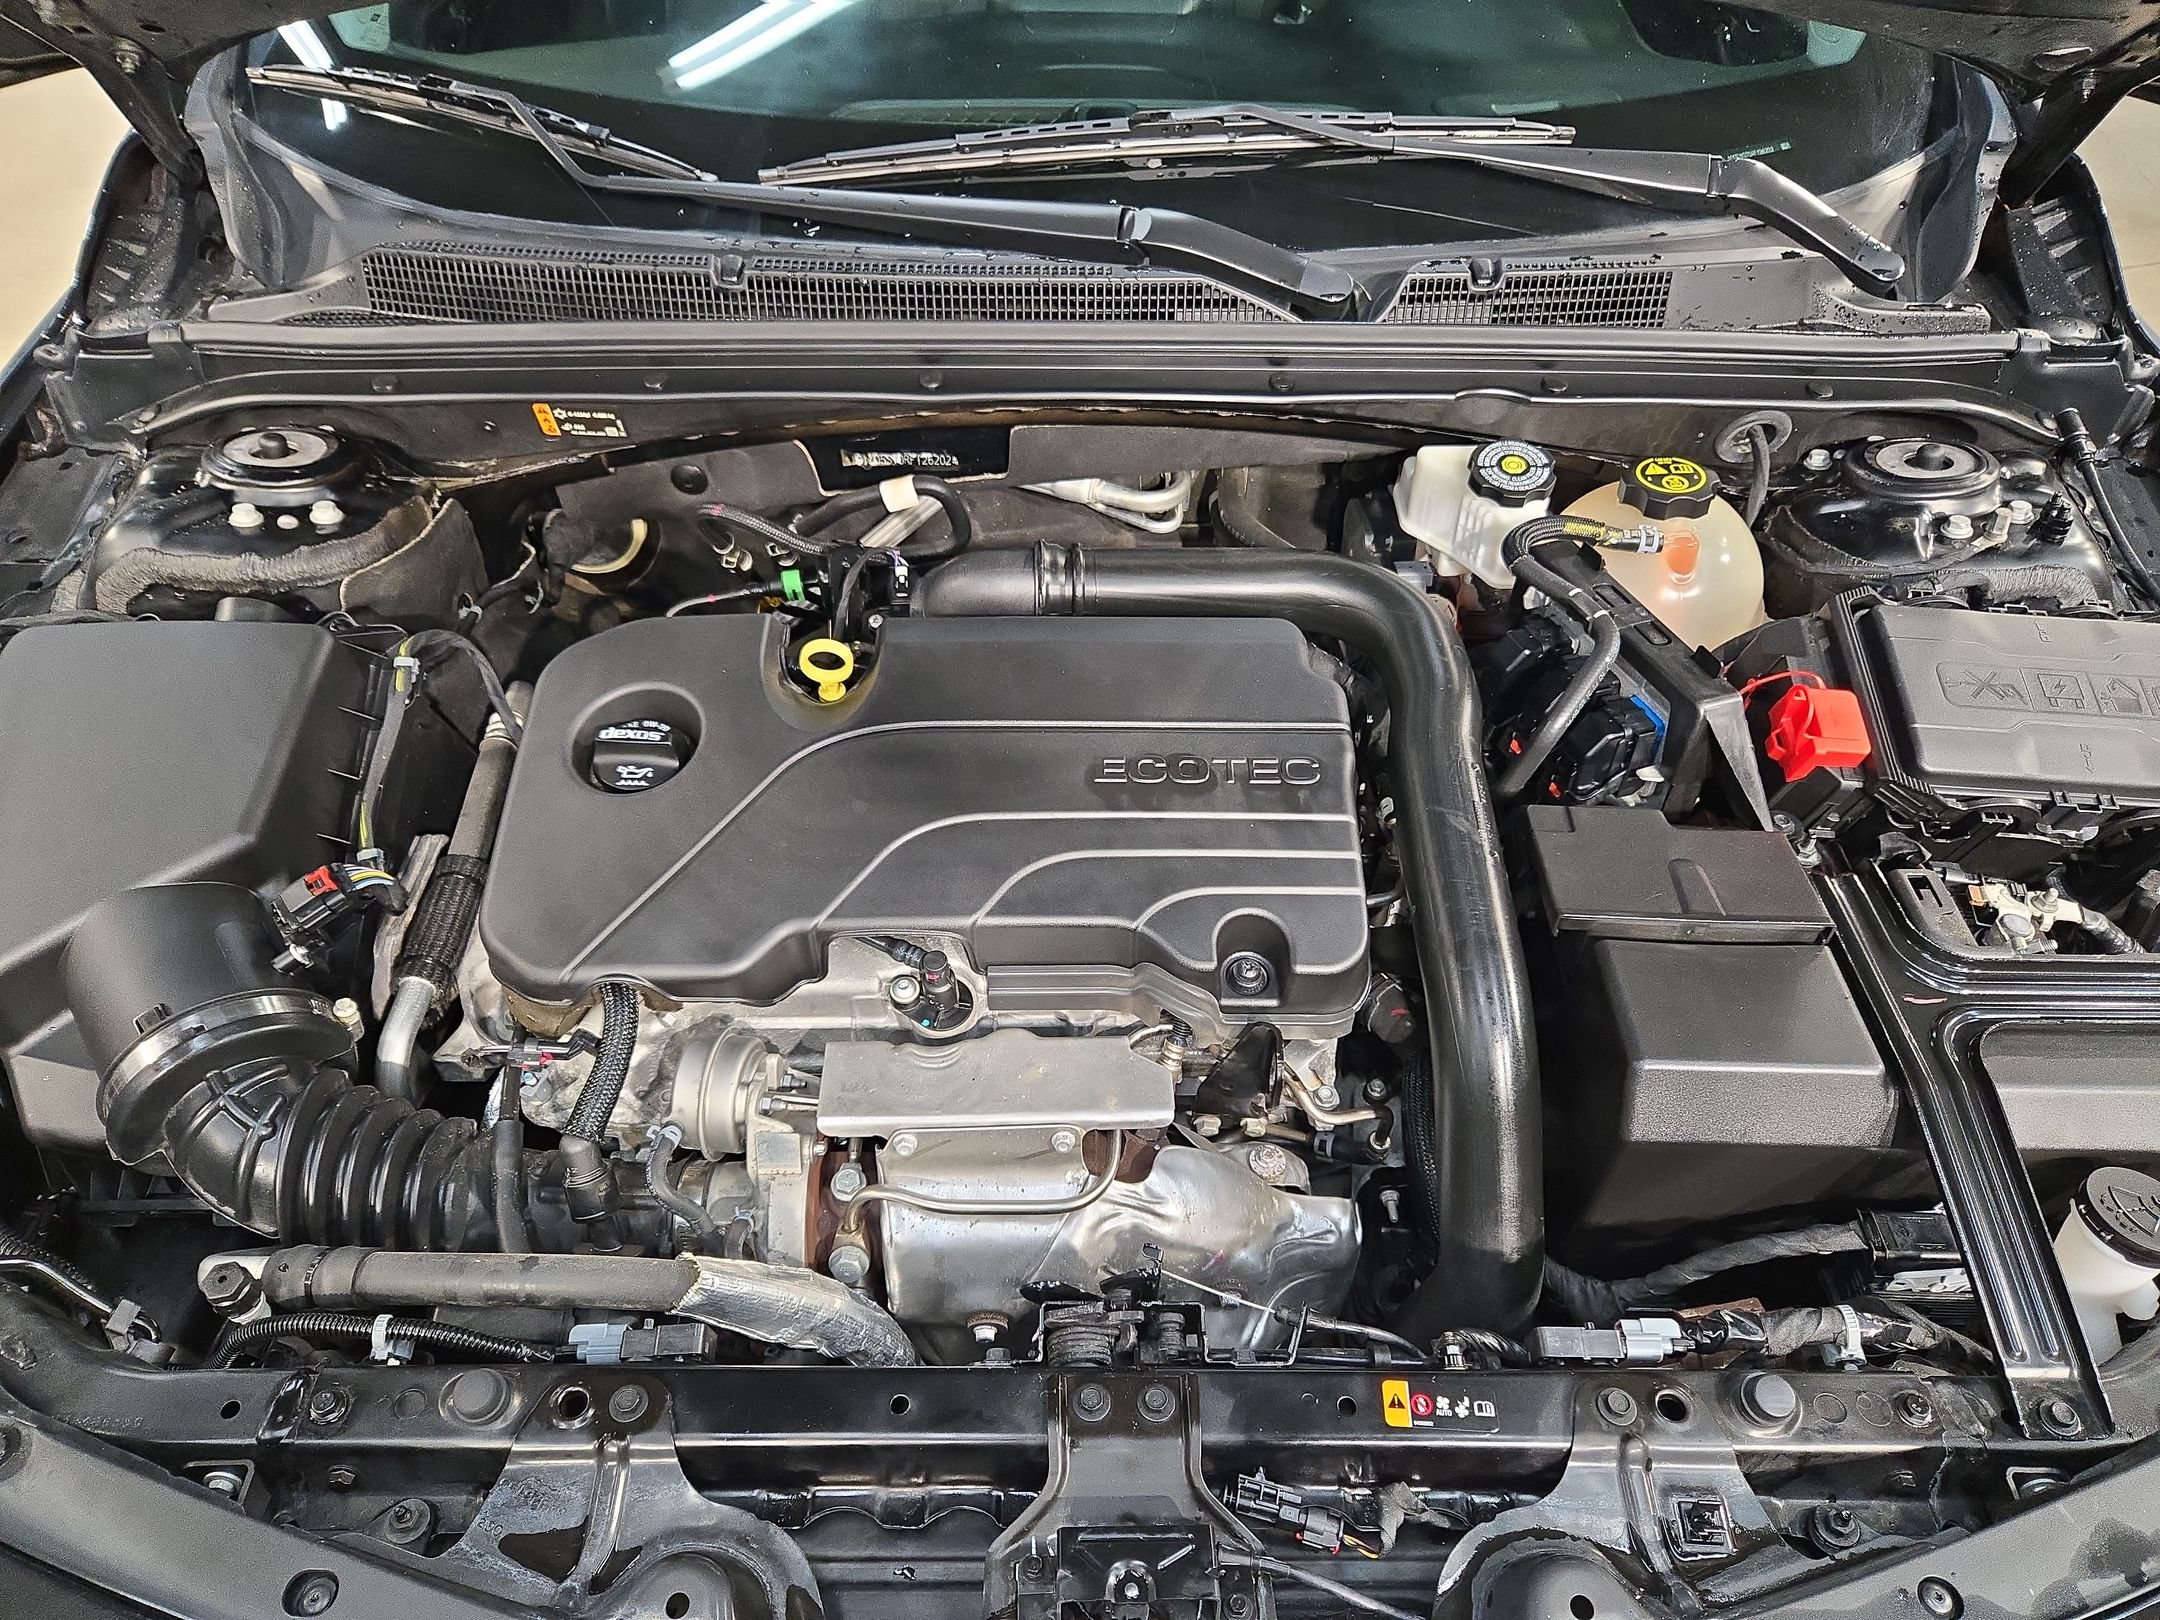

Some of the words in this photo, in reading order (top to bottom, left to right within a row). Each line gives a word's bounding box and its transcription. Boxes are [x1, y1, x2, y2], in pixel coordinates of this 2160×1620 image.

[598, 727, 665, 741] dexos
[1093, 755, 1321, 784] ECOTEC
[1436, 1409, 1453, 1417] AUTO
